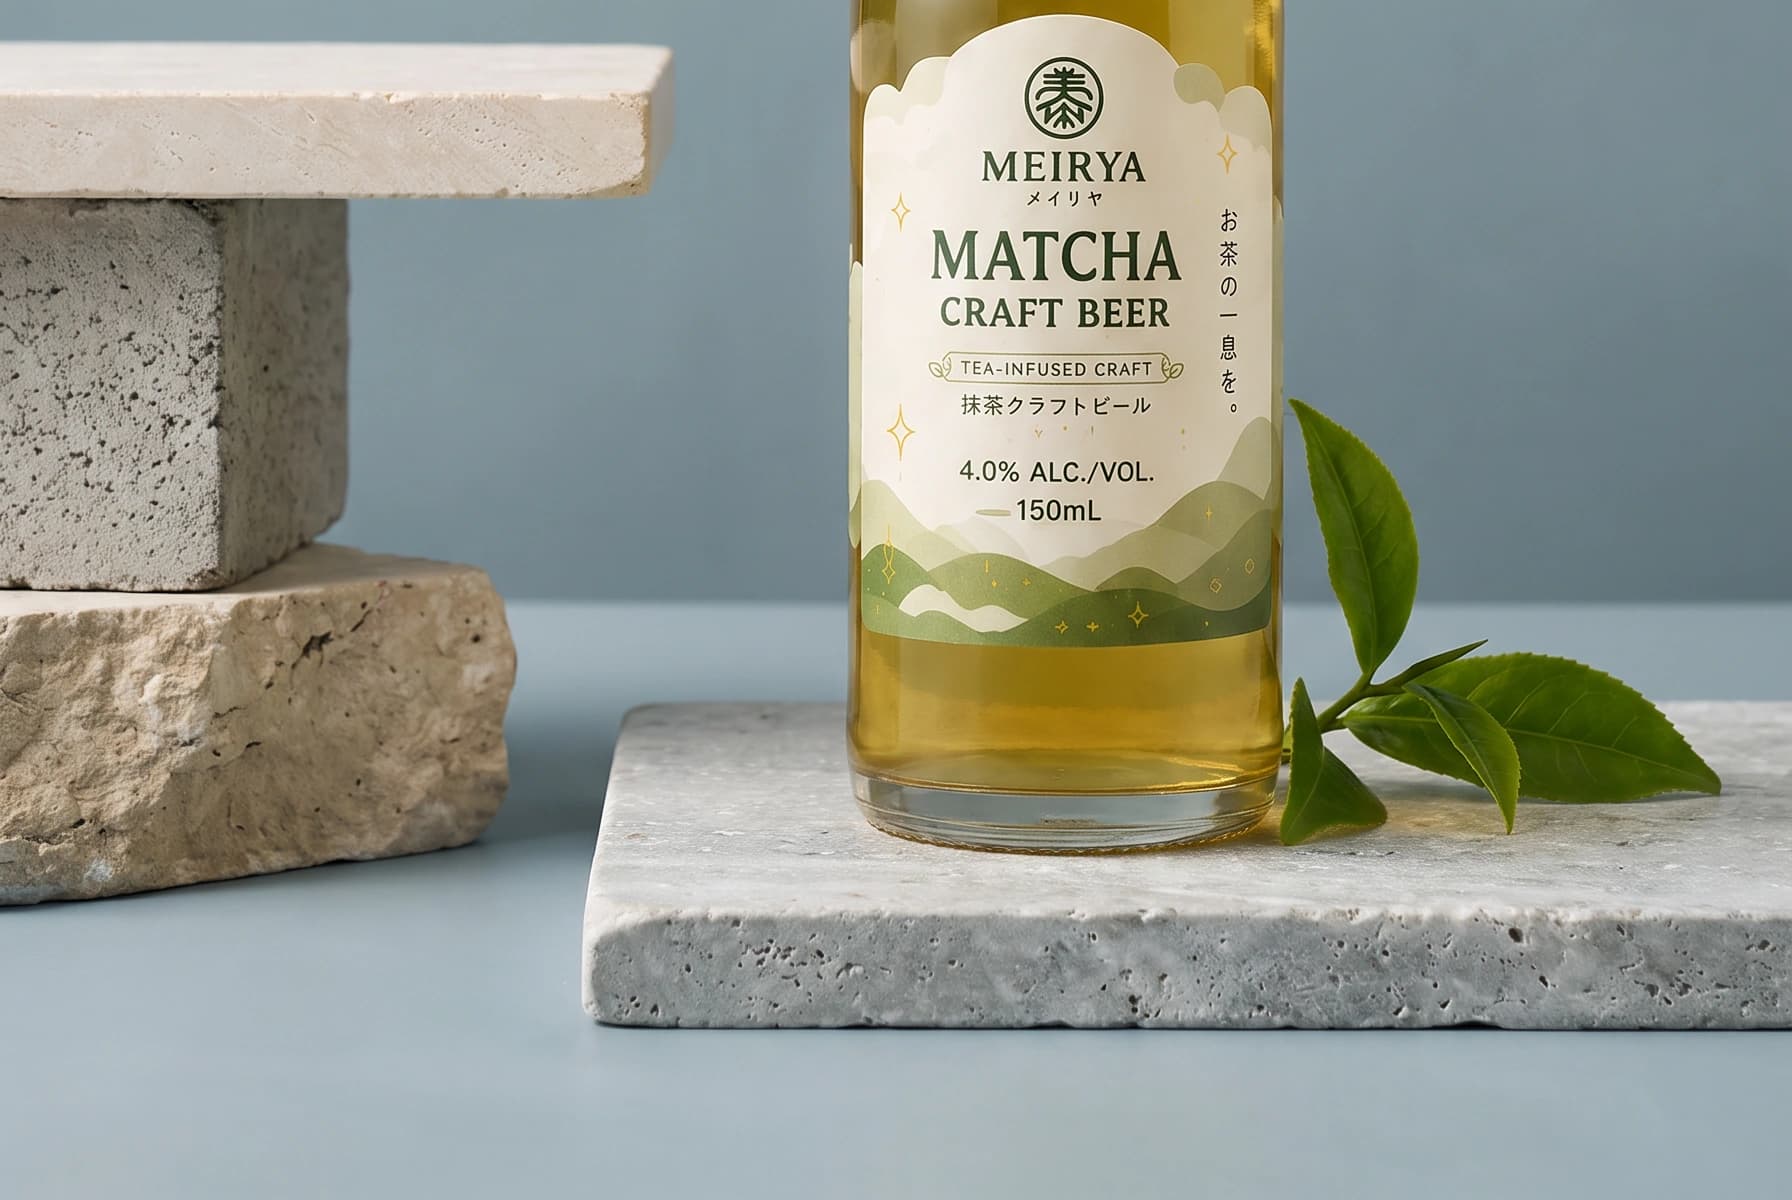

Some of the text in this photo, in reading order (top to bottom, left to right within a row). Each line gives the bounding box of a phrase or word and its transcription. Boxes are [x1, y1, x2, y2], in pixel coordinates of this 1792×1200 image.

[982, 151, 1146, 182] MEIRYA
[1027, 191, 1103, 207] メイリヤ
[931, 230, 1182, 282] MATCHA
[941, 296, 1170, 328] CRAFT BEER
[1219, 208, 1238, 413] お茶の一息を。
[961, 360, 1152, 377] TEA-INFUSED CRAFT
[961, 394, 1151, 416] 抹茶クラフトビール
[960, 460, 1154, 484] 4.0% ALC./VOL.
[1017, 499, 1102, 521] 150mL
